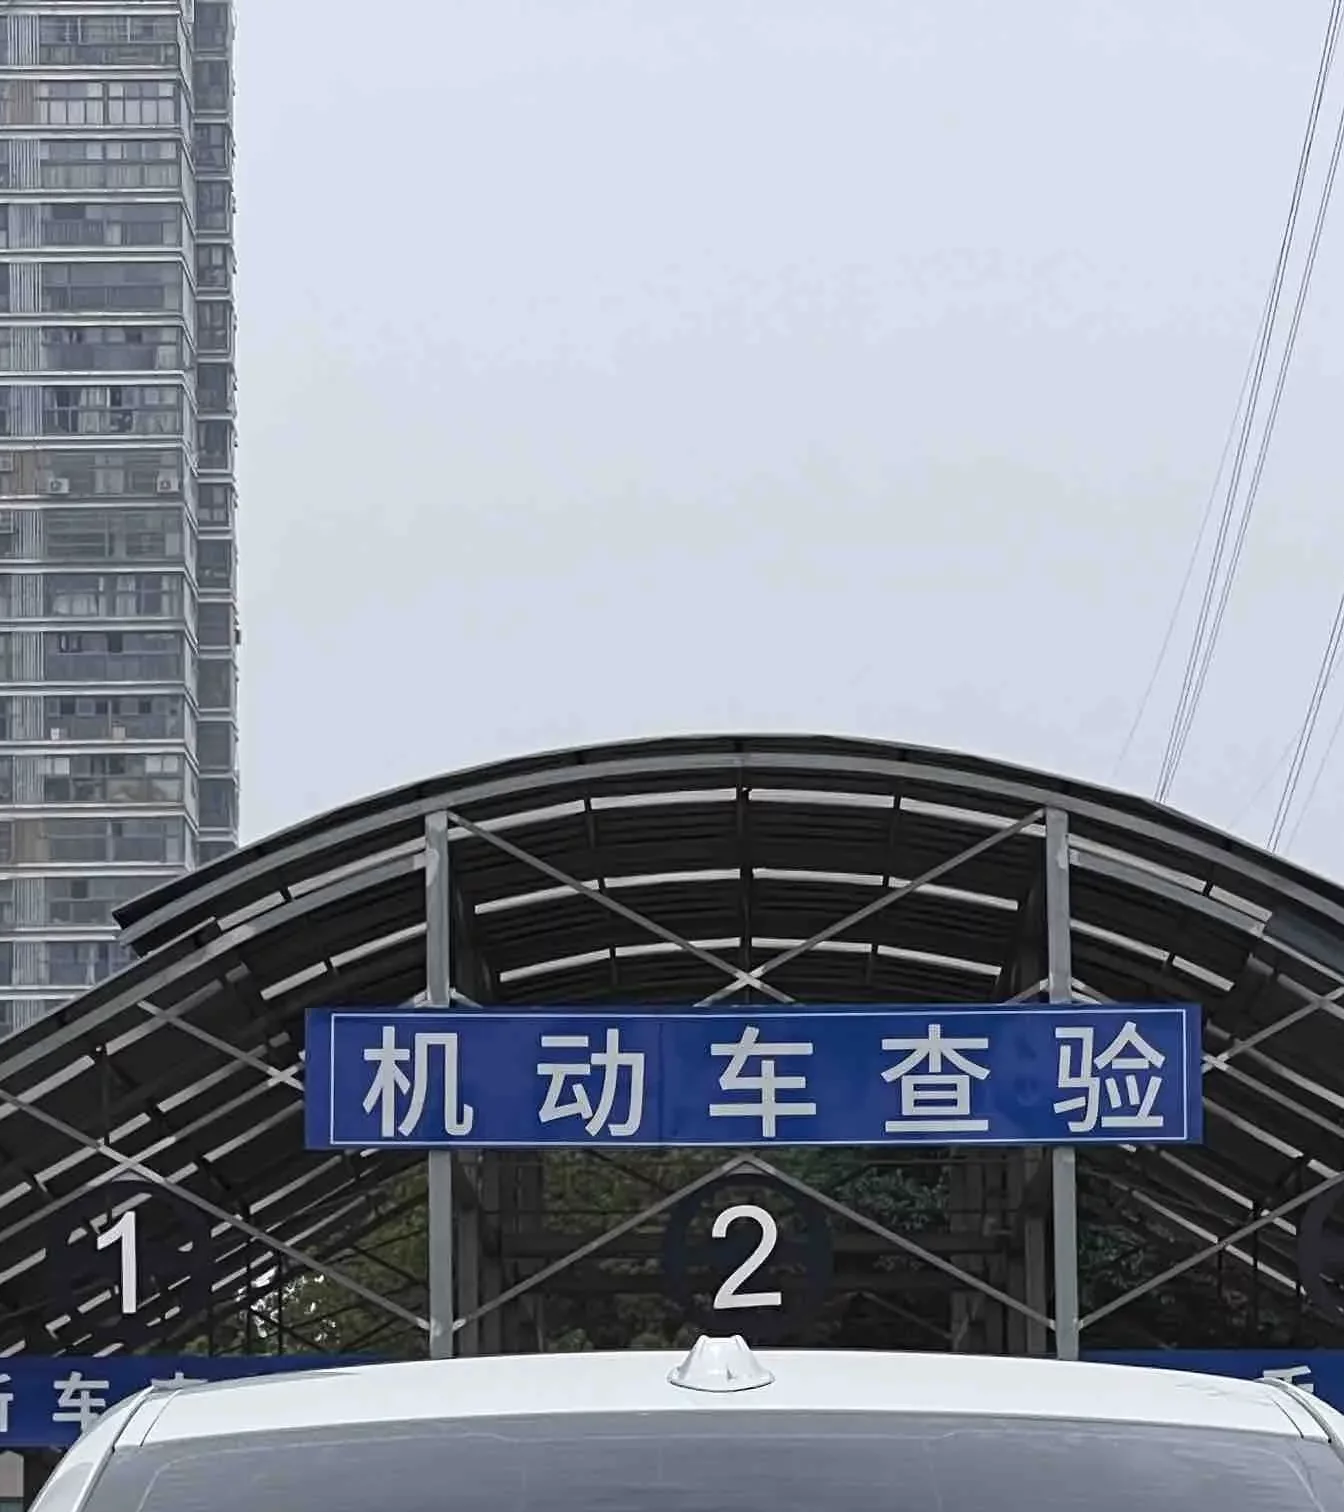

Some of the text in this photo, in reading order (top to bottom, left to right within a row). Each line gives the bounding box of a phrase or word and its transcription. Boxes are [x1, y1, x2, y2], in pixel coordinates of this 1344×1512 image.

[361, 1022, 1166, 1138] 机动车查验
[97, 1211, 137, 1313] 1
[711, 1204, 783, 1310] 2
